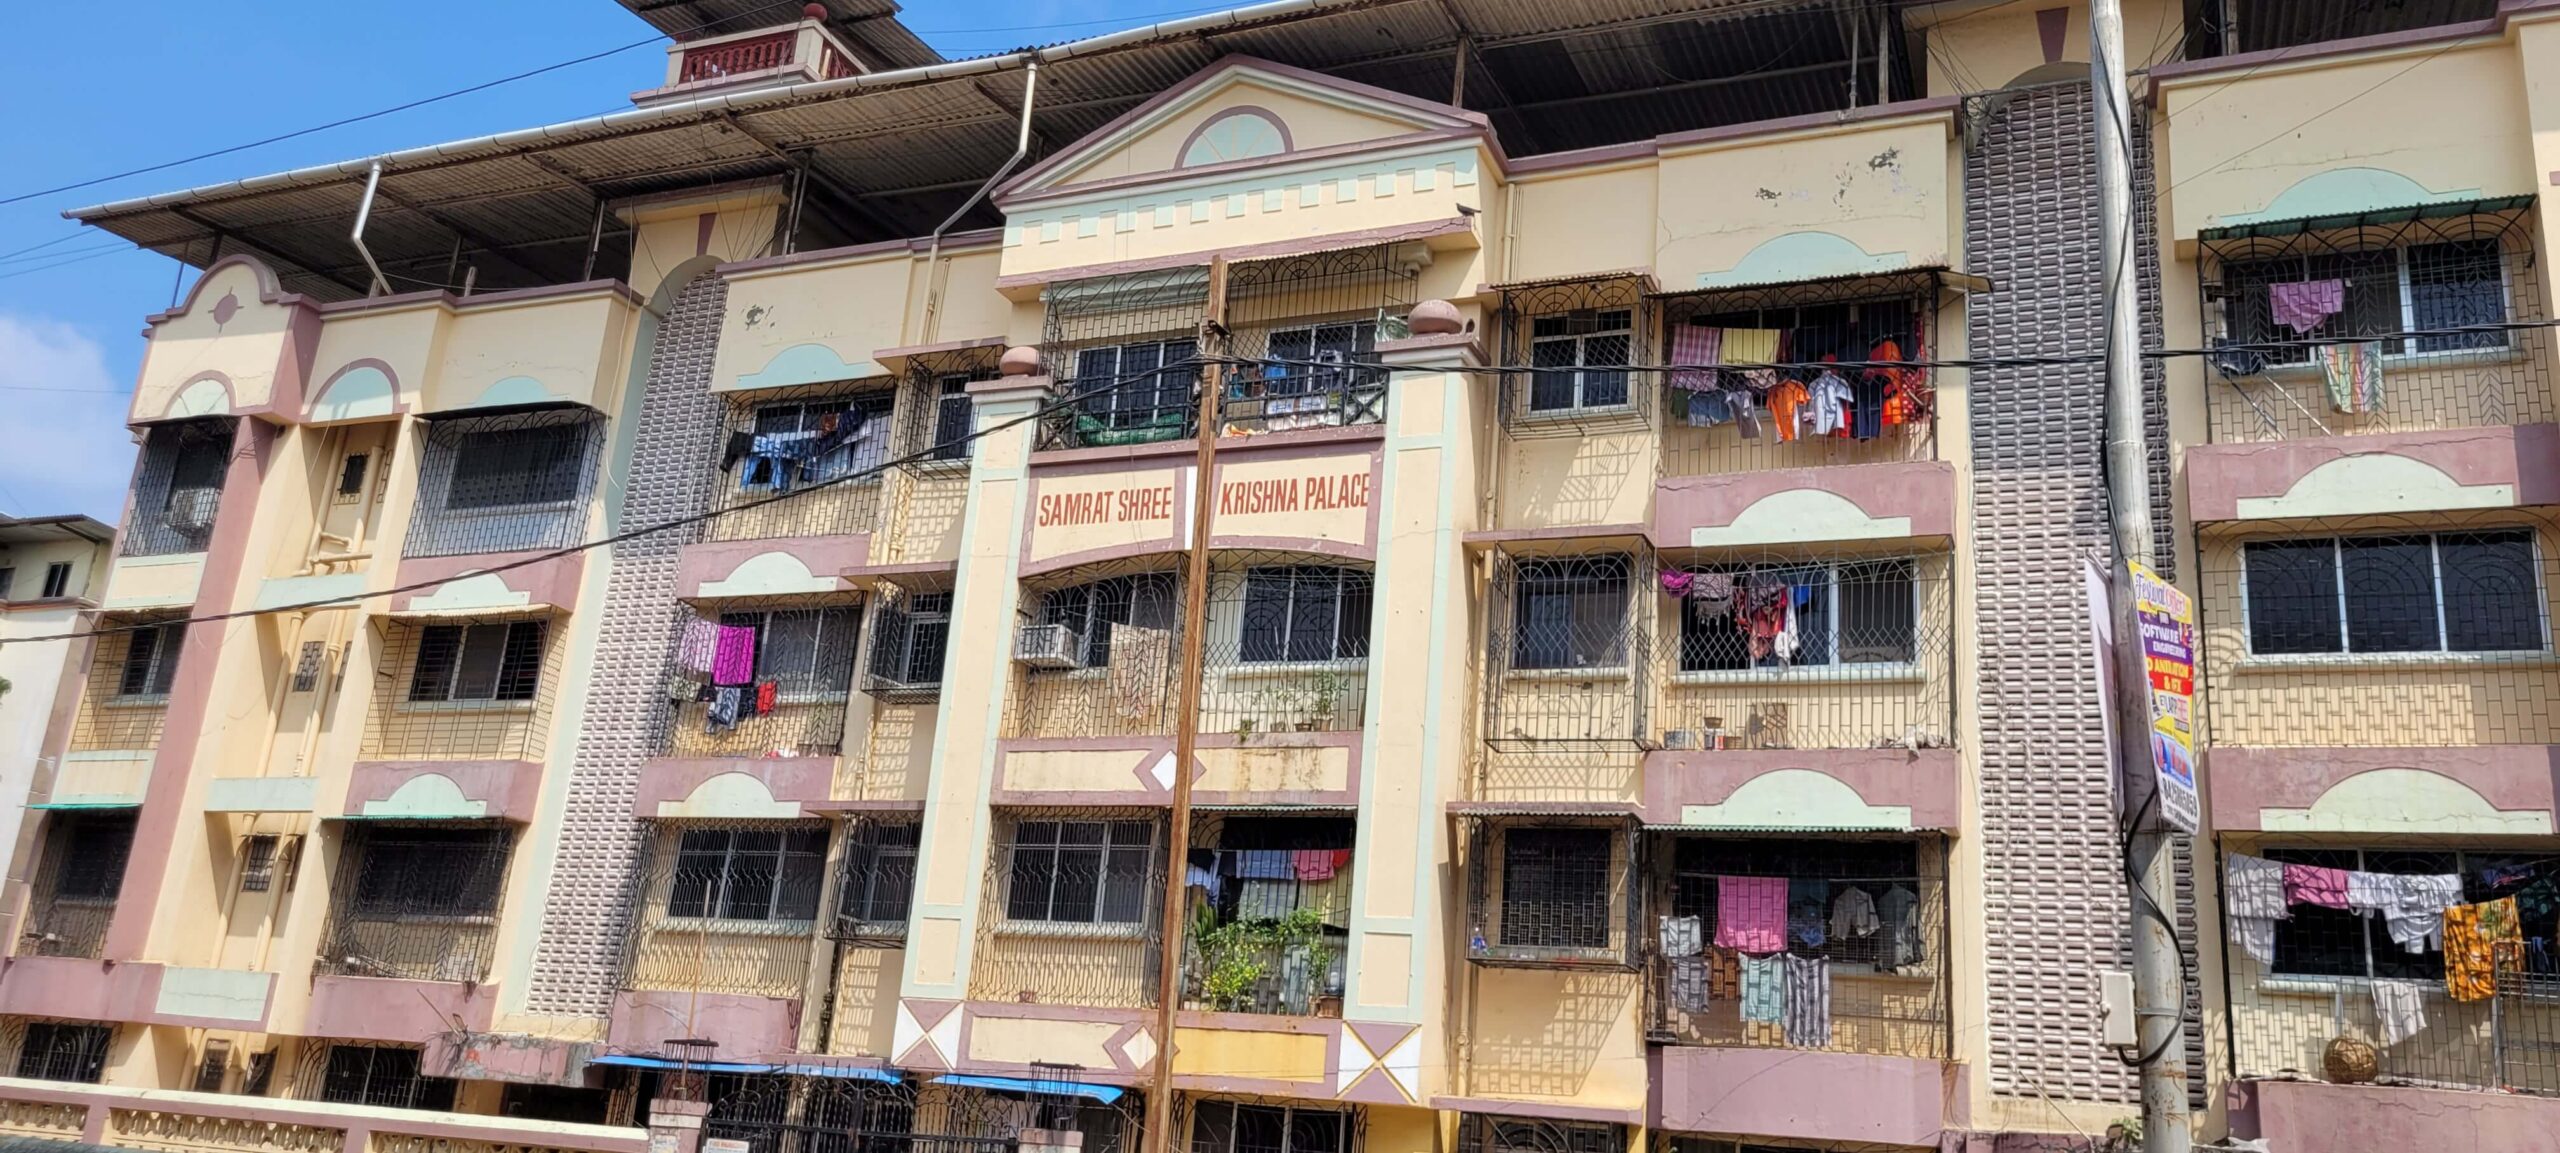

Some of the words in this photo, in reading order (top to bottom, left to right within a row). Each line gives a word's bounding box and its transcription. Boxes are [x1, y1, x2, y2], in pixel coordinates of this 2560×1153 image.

[1039, 490, 1114, 527] SAMRAT
[1118, 486, 1172, 521] SHREE
[1220, 478, 1298, 515] KRISHNA
[1304, 473, 1370, 511] PALACE
[2135, 573, 2165, 604] Festival
